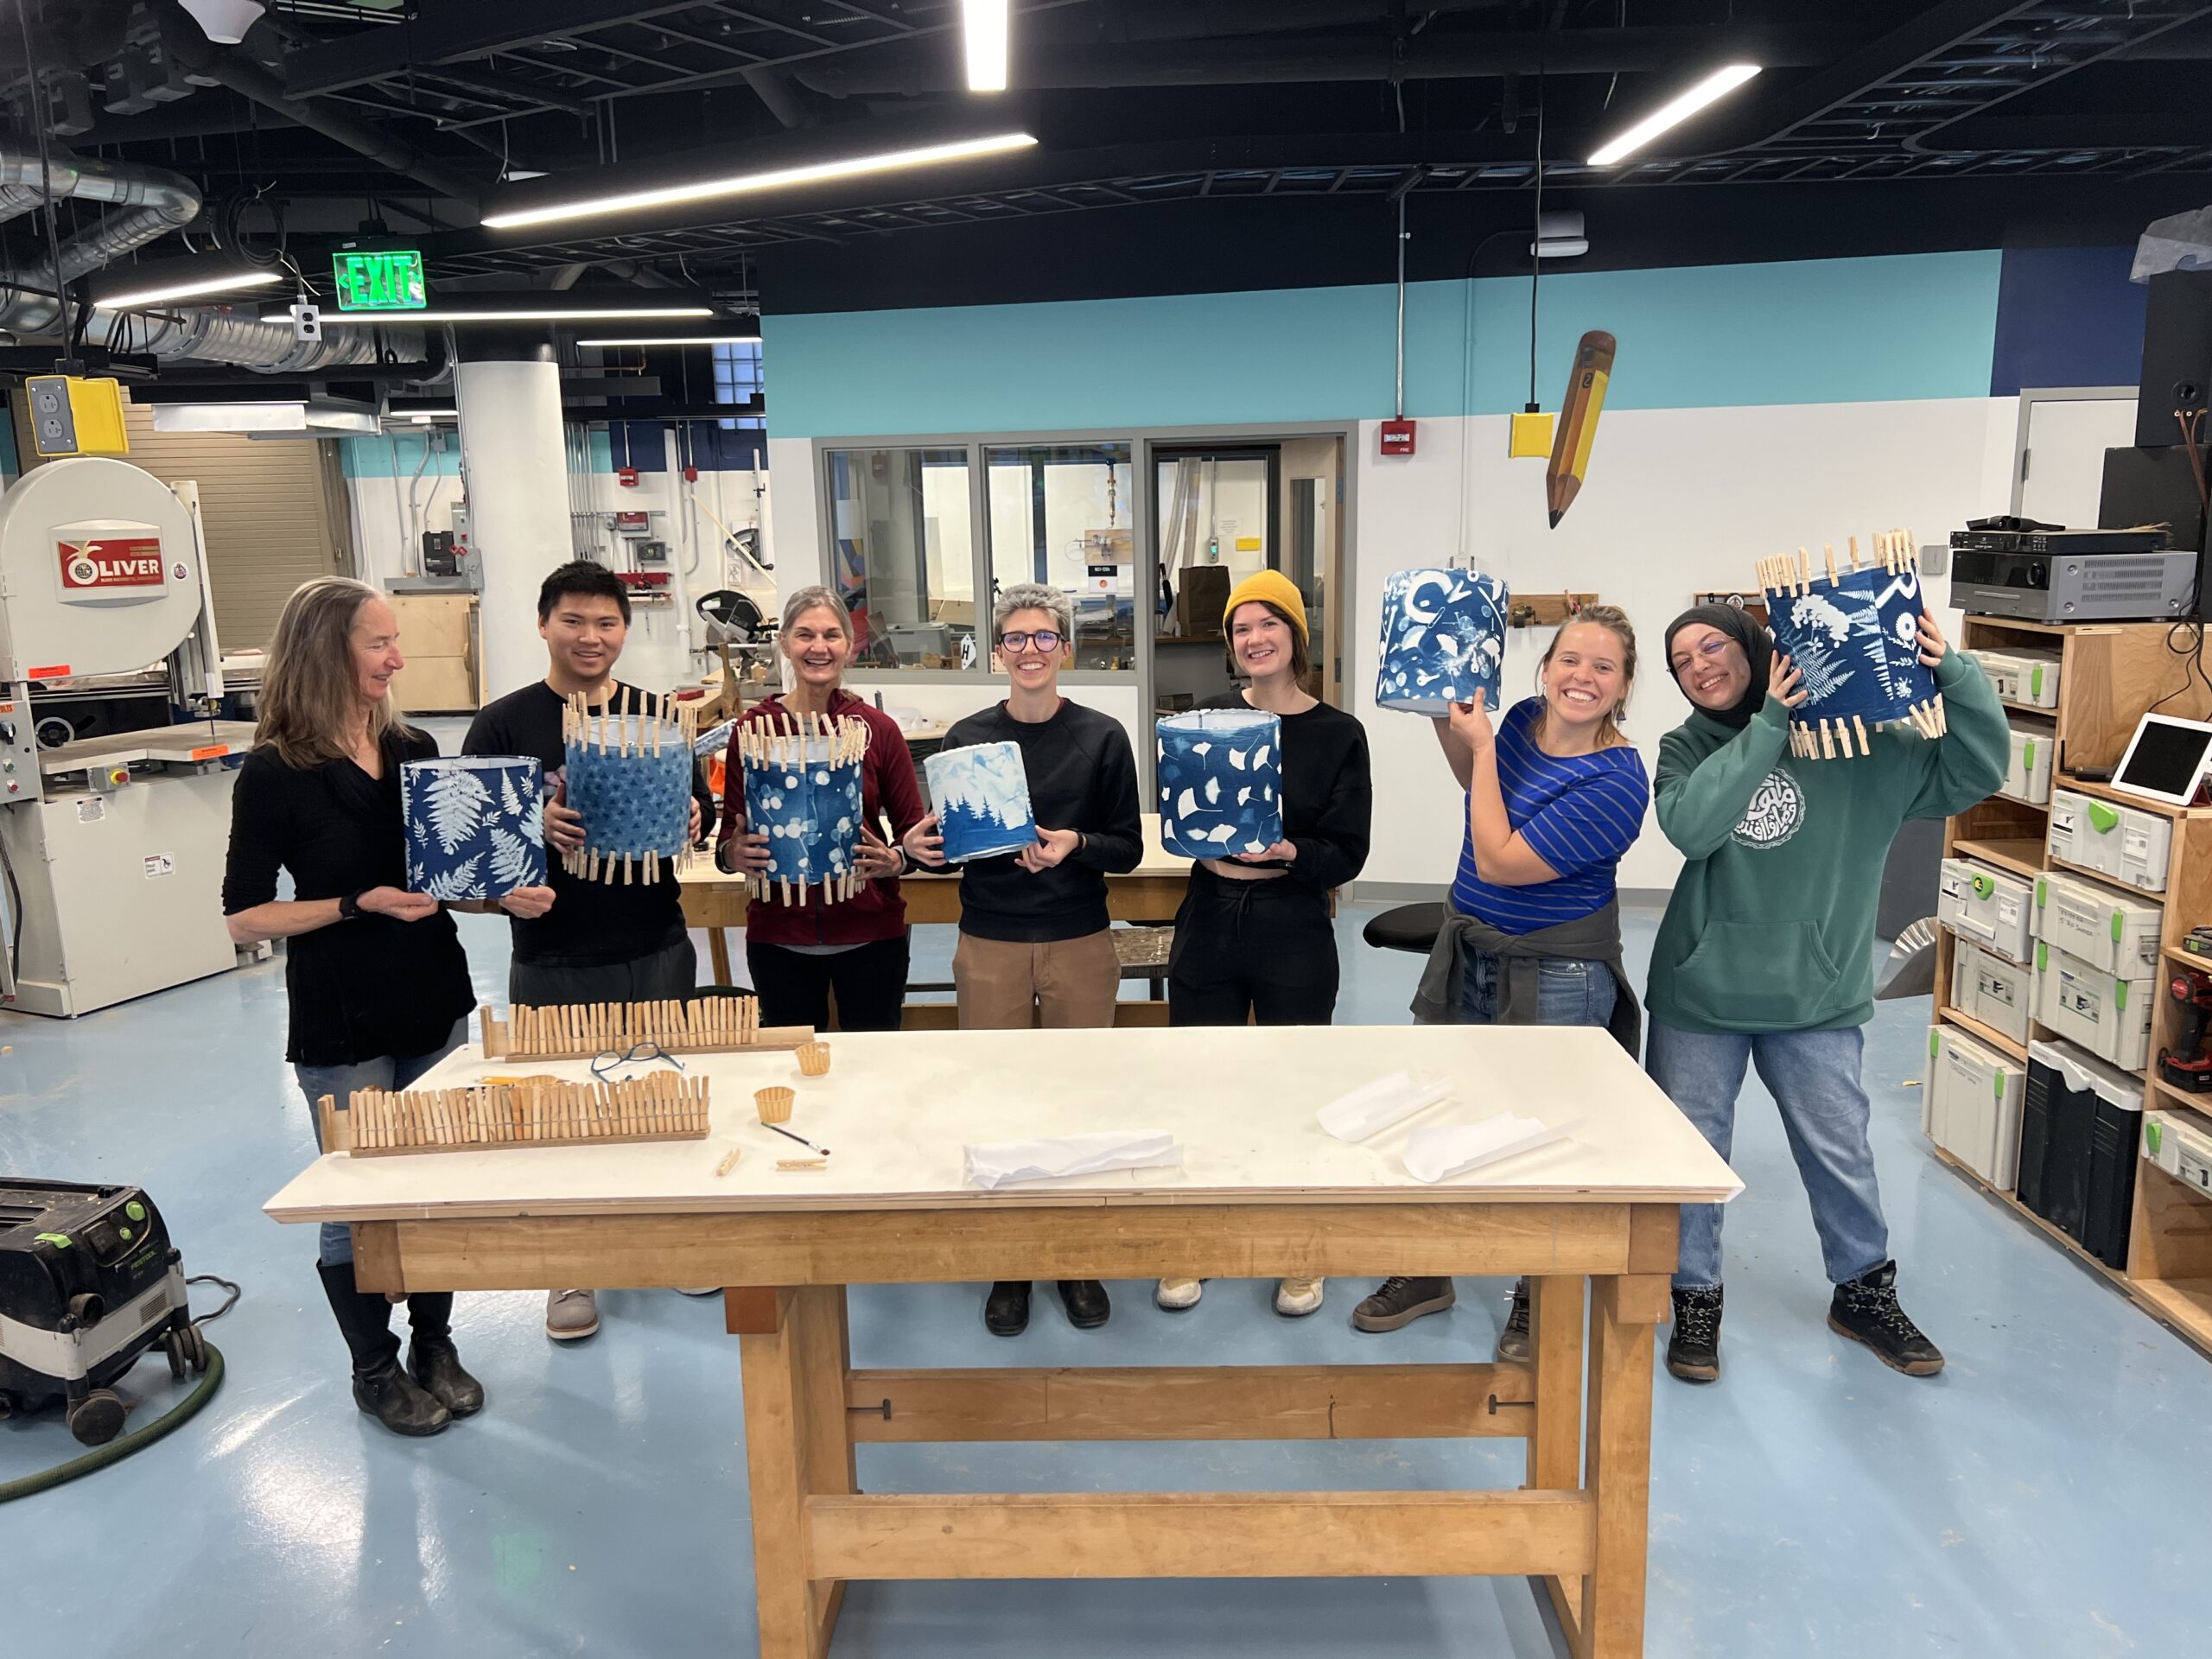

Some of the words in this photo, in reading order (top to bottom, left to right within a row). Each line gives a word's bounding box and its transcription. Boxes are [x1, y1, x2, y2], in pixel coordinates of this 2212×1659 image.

[346, 256, 412, 304] EXIT
[68, 557, 159, 585] OLIVER
[962, 644, 969, 660] H
